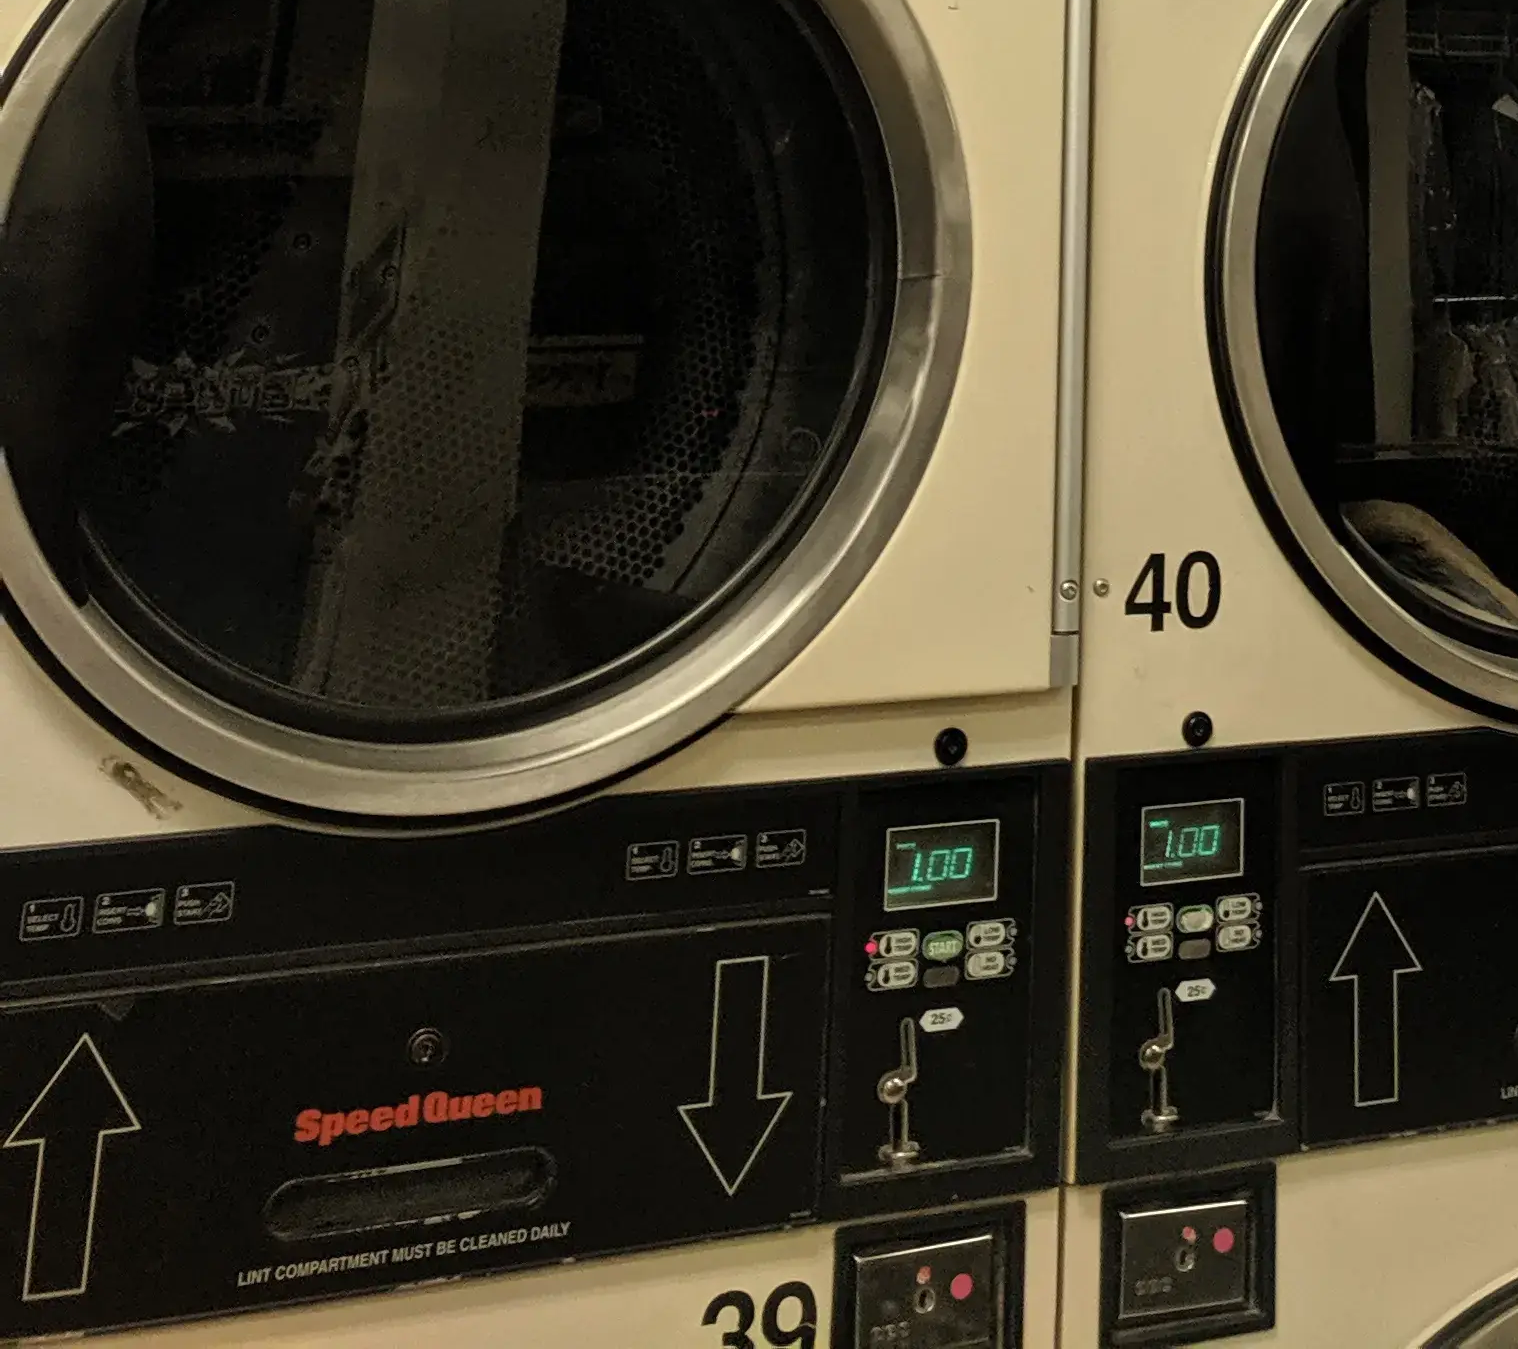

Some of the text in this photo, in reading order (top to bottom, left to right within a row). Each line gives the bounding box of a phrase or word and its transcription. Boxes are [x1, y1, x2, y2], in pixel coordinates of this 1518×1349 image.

[1124, 550, 1222, 632] 40
[293, 1086, 544, 1146] Speed Queen
[237, 1221, 572, 1287] LINT COMPARTMENT MUST BE CLEANED DAILY
[701, 1281, 817, 1349] 39
